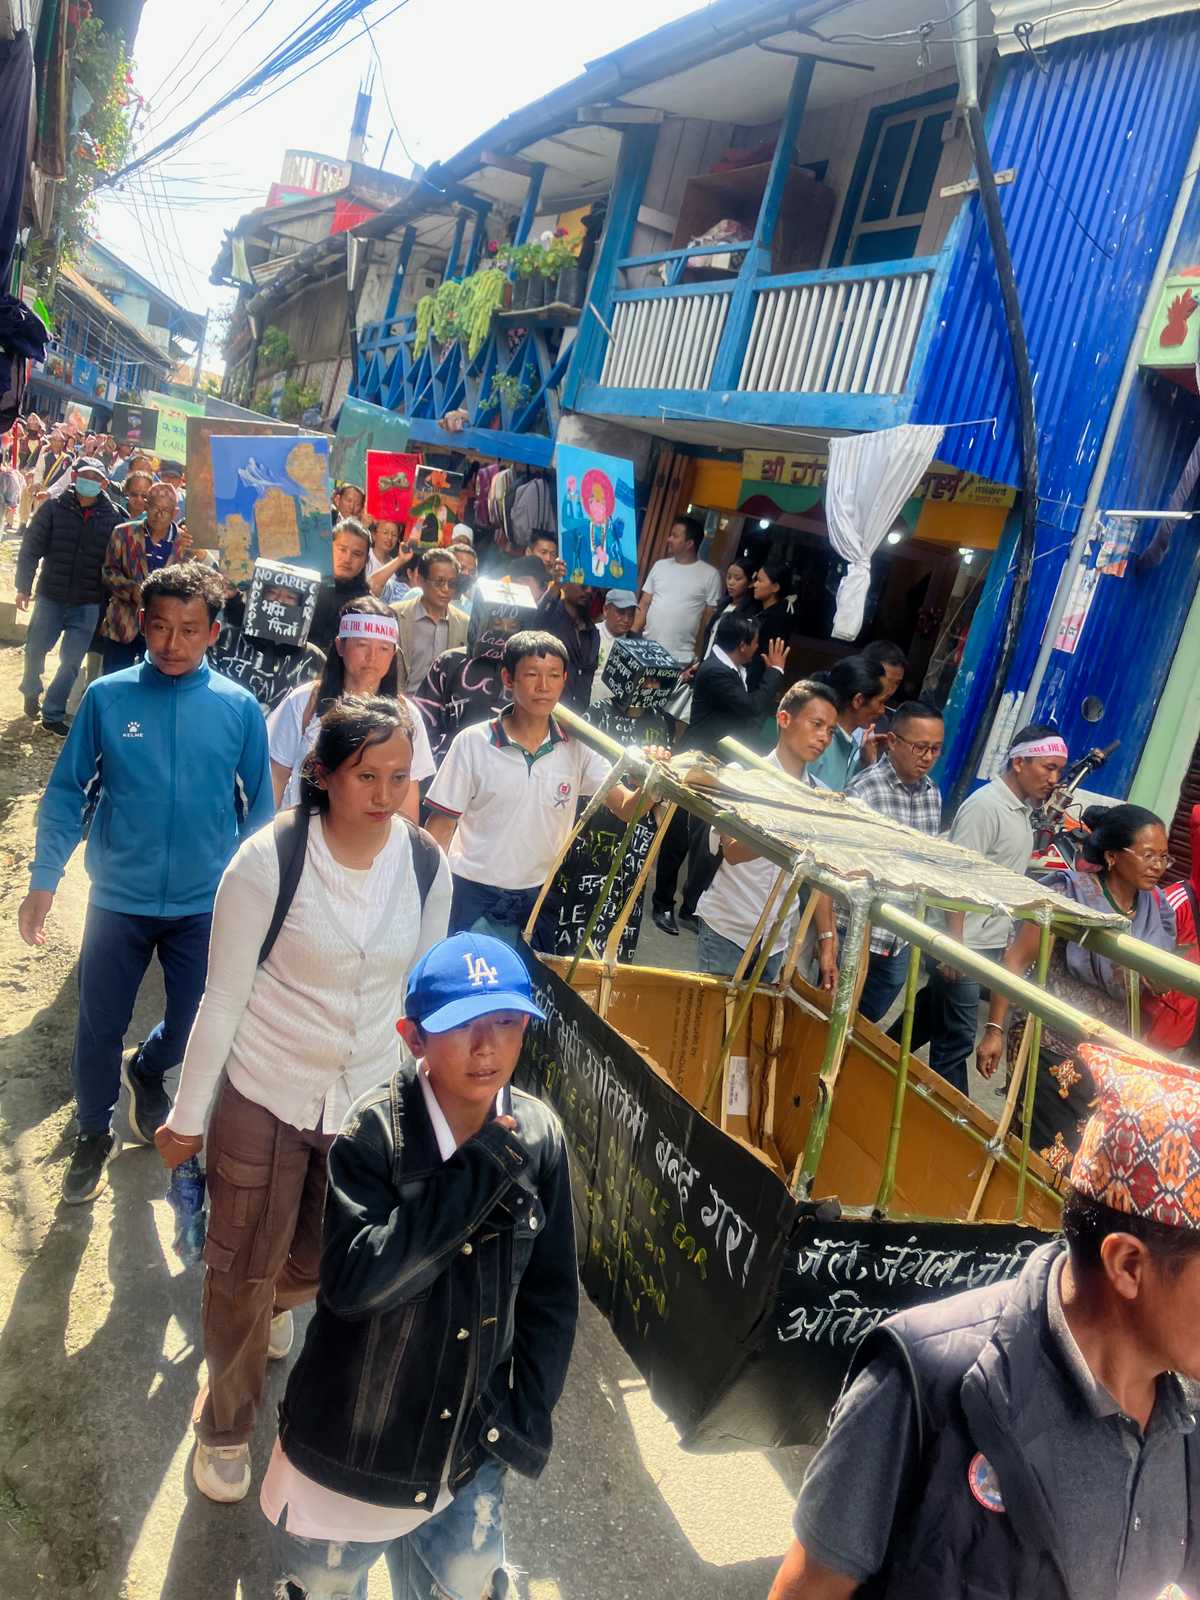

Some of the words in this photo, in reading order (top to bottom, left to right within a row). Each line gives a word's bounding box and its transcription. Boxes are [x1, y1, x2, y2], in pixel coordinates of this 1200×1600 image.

[254, 567, 272, 581] NO
[274, 573, 308, 592] CABLE
[302, 583, 318, 620] CAR
[463, 952, 498, 986] LA
